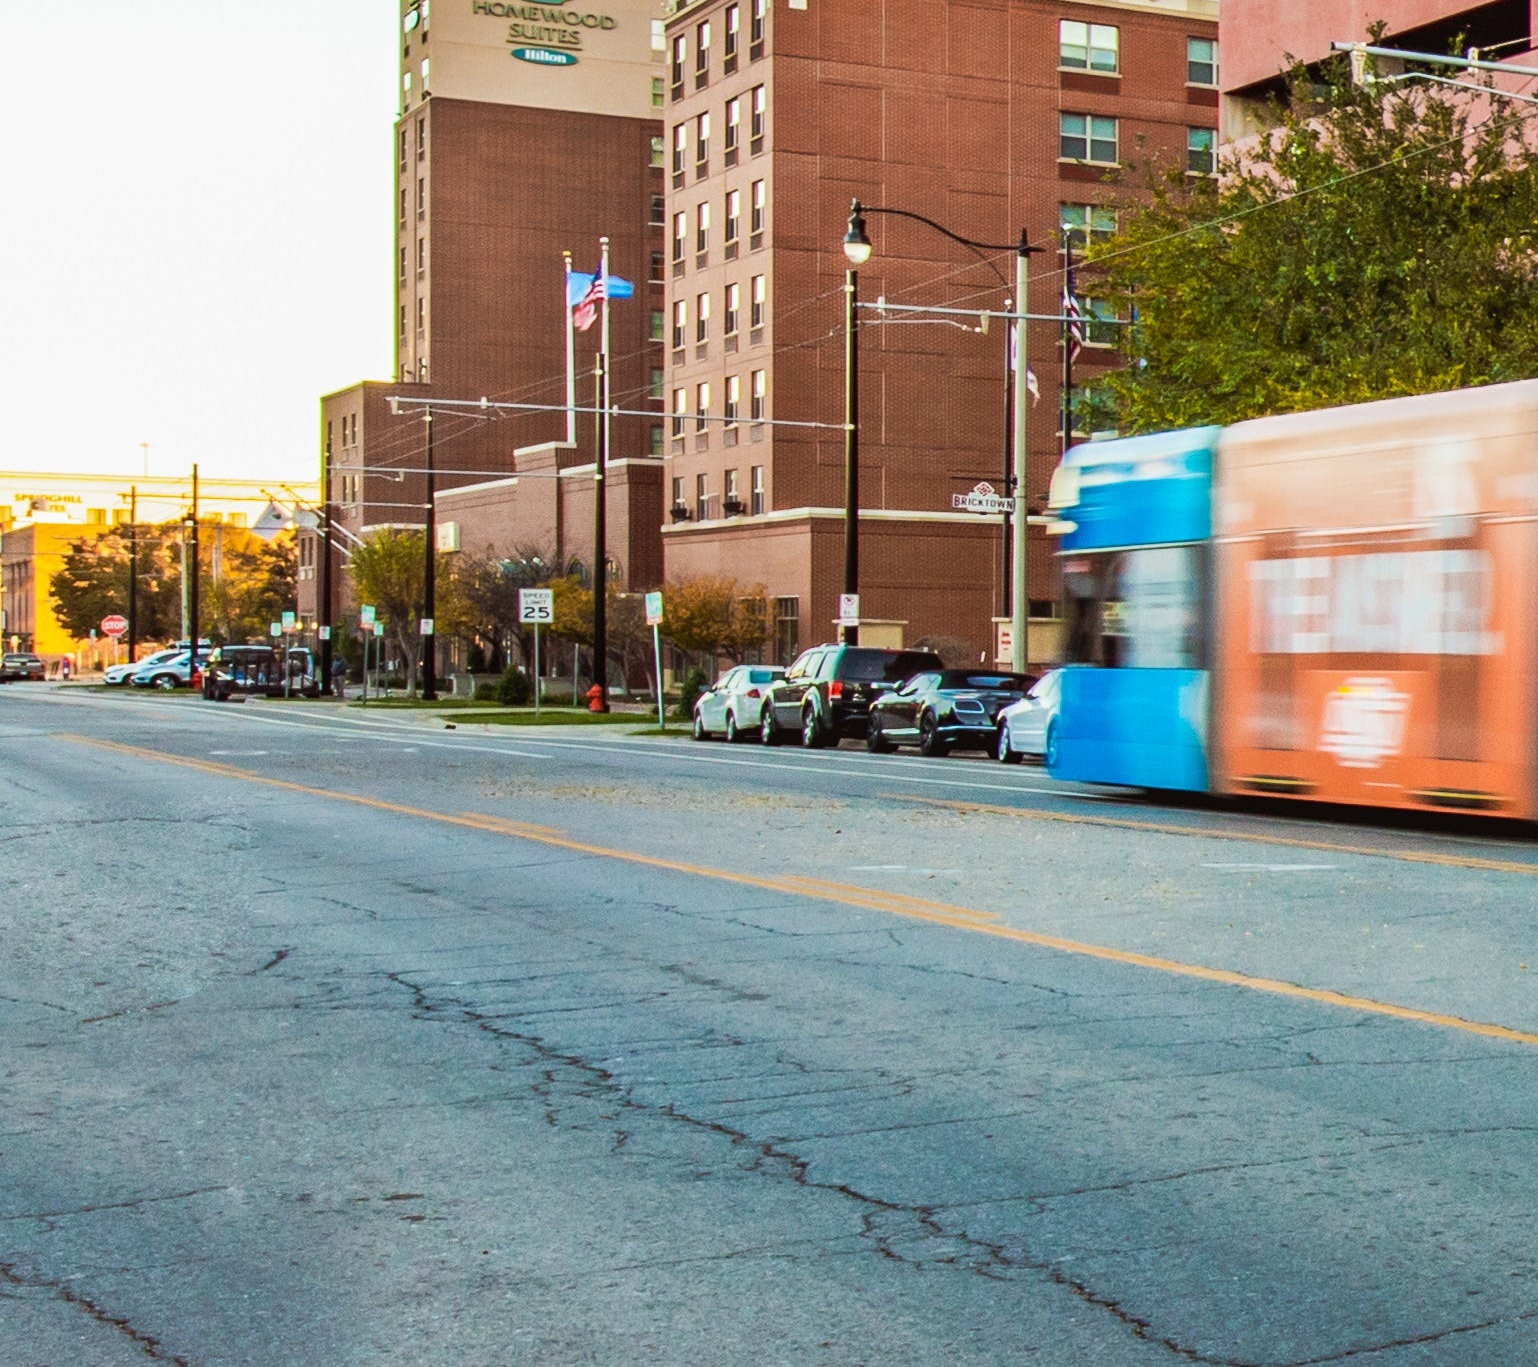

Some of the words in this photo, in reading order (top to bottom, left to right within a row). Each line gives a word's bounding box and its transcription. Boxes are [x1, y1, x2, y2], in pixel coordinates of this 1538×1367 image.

[473, 0, 618, 30] HOMEWOOD
[508, 22, 582, 45] SUITES
[524, 48, 568, 64] Hilton
[953, 494, 1014, 510] BRICKTOWN
[523, 606, 551, 619] 25
[103, 619, 127, 630] STOP
